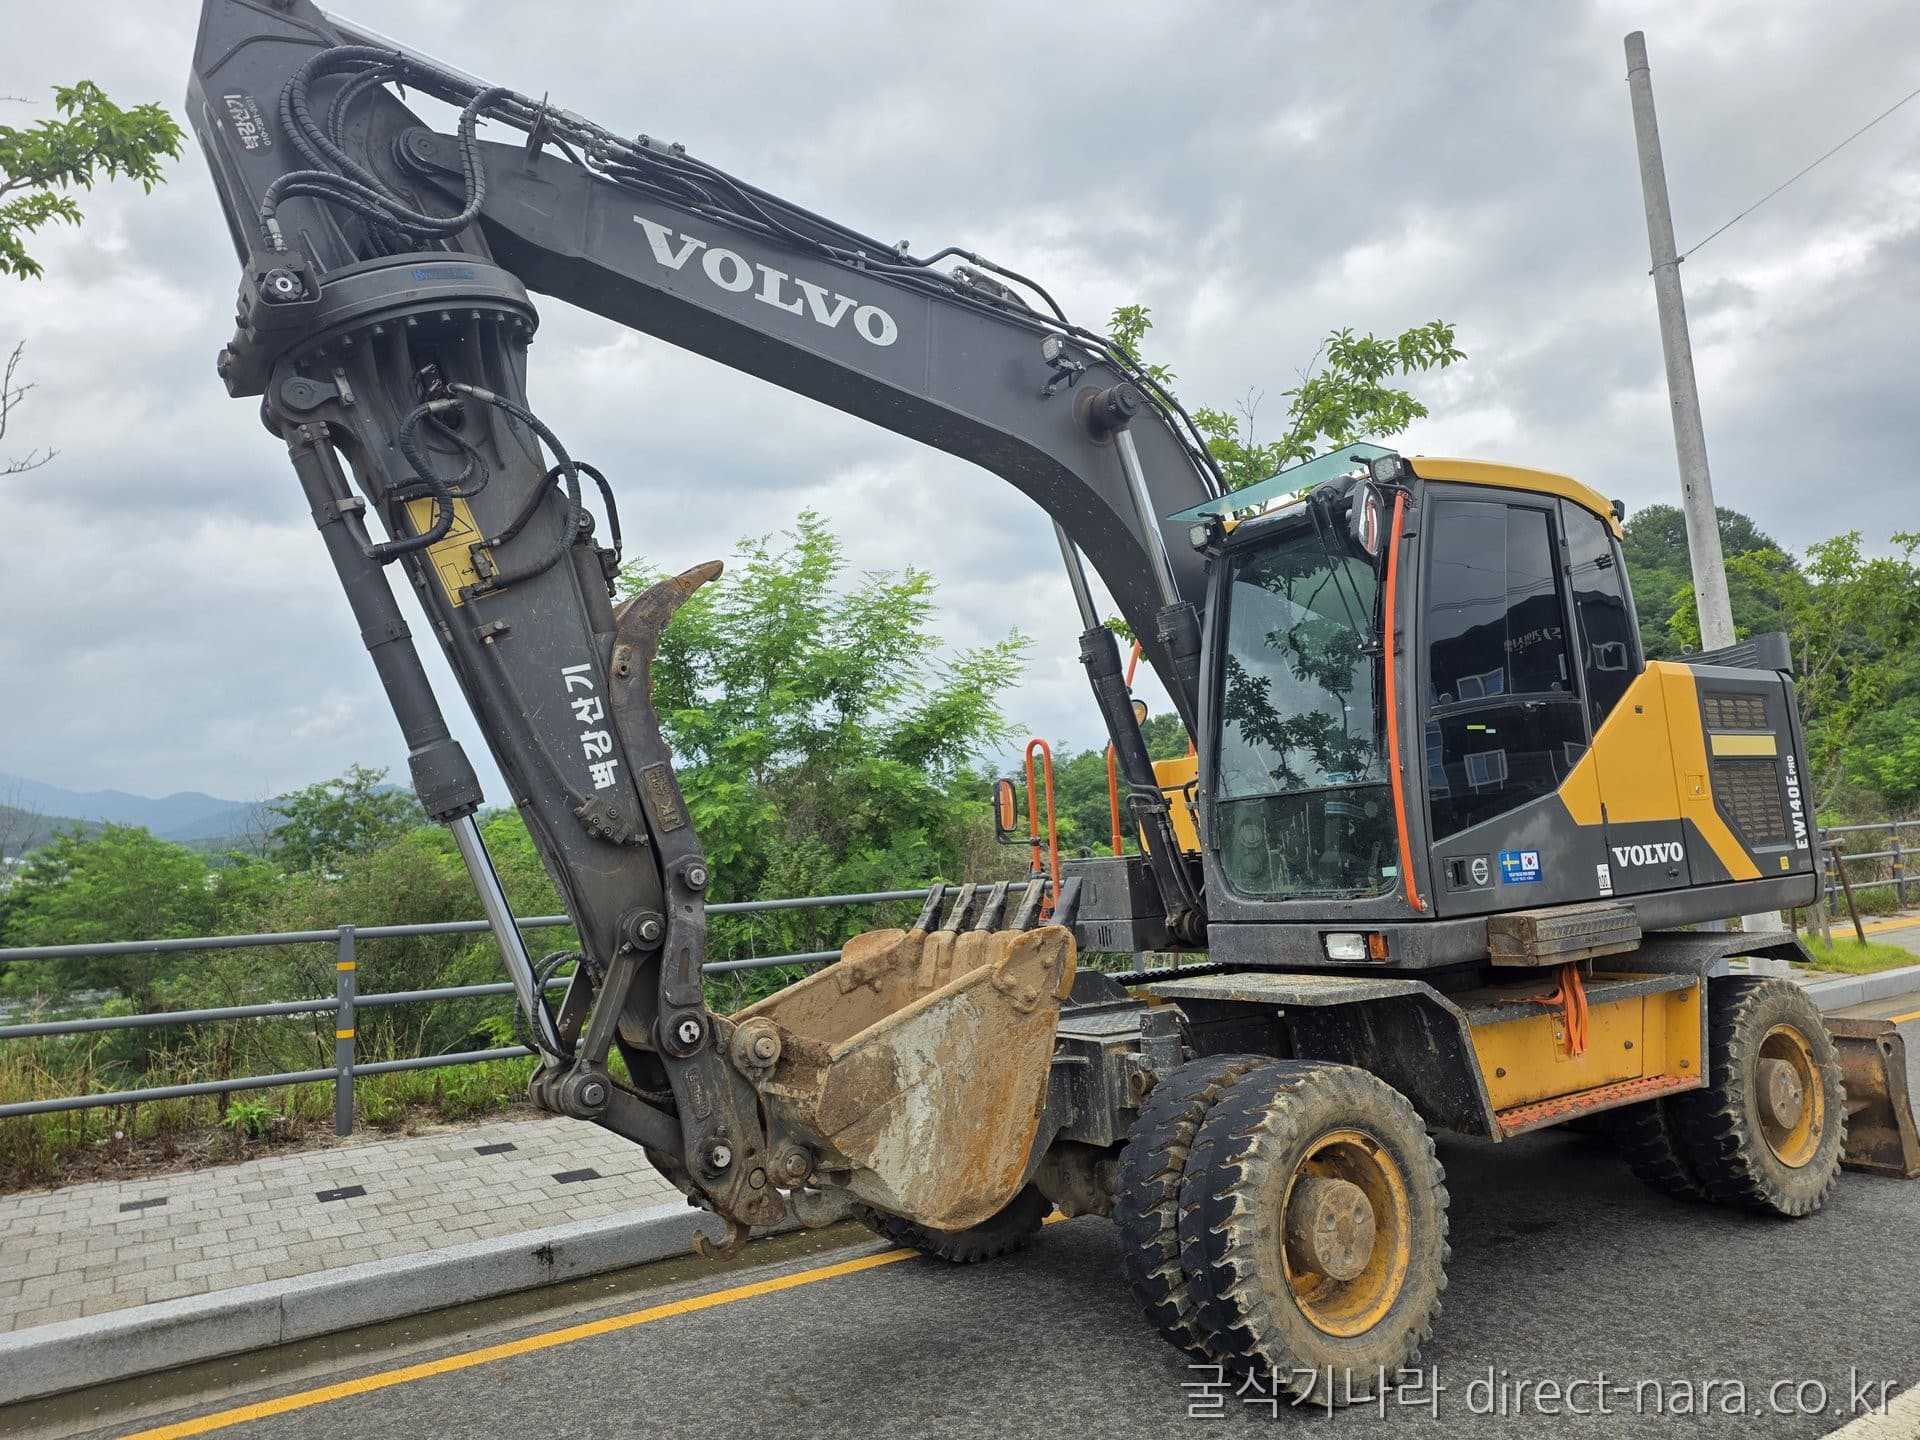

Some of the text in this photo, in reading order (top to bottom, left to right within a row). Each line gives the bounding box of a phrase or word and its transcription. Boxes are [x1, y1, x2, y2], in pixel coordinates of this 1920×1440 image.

[633, 215, 898, 346] VOLVO
[561, 663, 618, 790] 벽강산기
[1612, 842, 1684, 867] VOLVO
